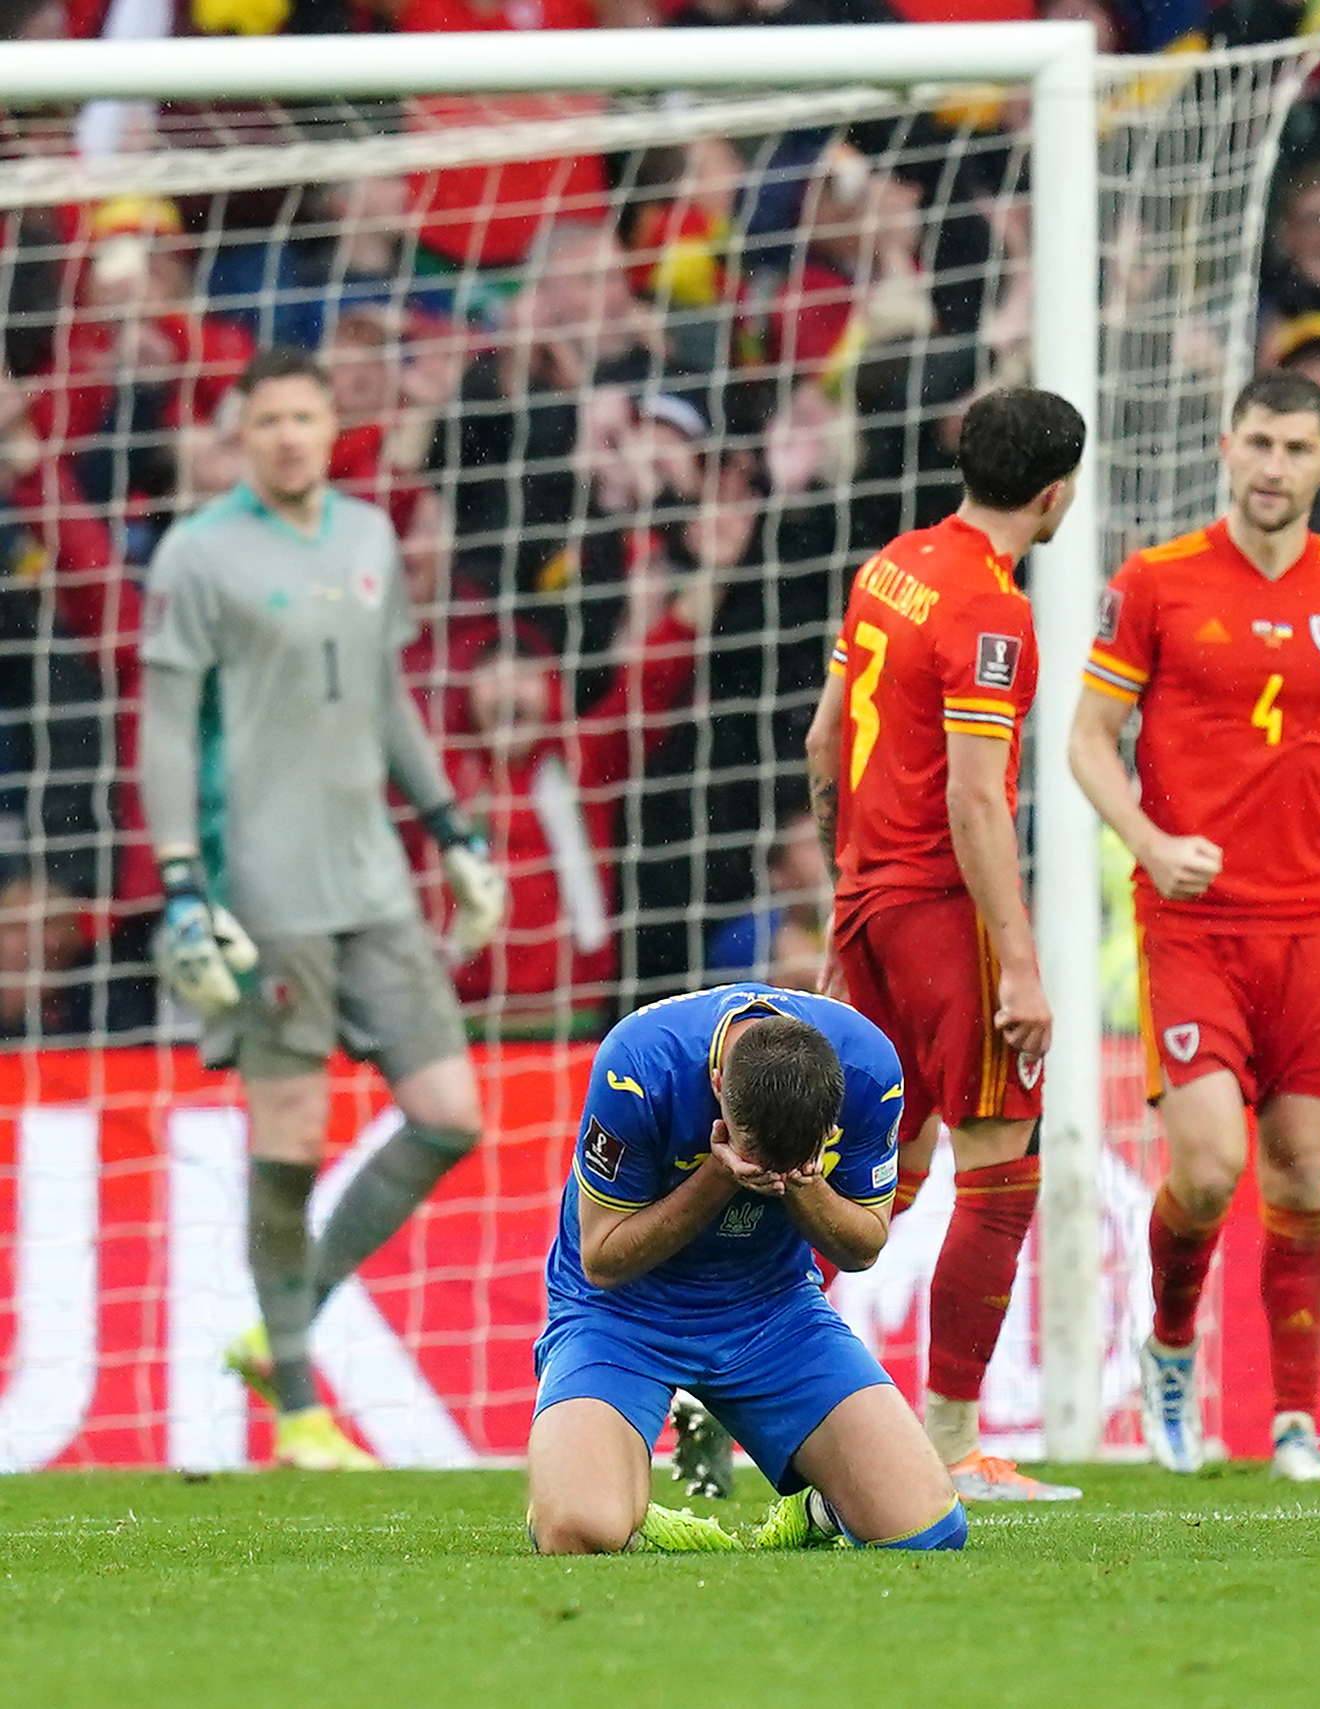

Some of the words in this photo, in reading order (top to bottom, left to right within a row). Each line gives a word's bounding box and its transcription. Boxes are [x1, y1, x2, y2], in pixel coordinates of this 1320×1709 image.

[324, 638, 342, 704] 1
[851, 621, 888, 793] 3
[1252, 673, 1284, 747] 4
